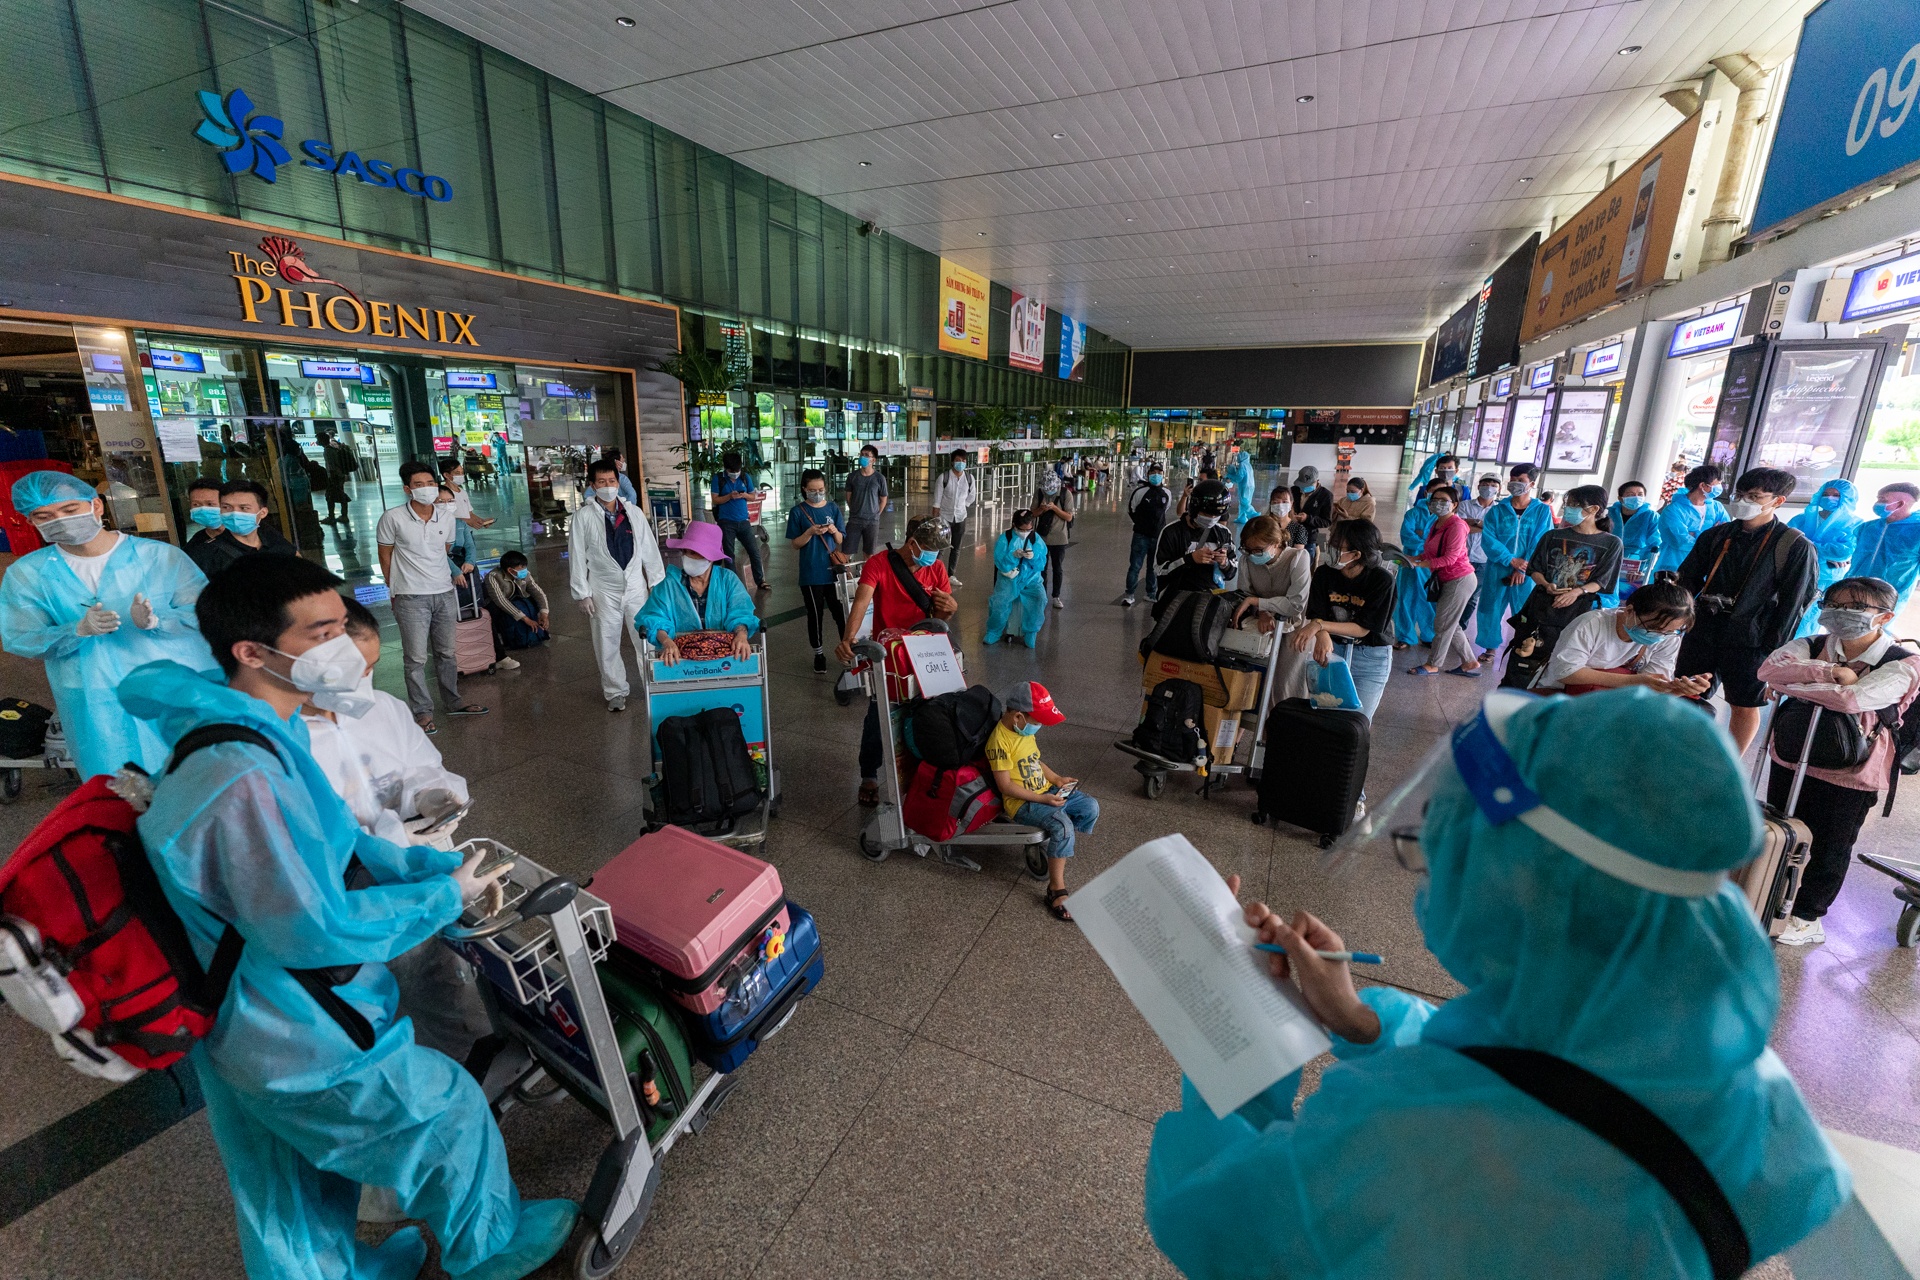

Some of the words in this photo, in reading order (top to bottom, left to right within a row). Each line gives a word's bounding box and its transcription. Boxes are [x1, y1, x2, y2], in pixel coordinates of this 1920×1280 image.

[1845, 43, 1920, 156] 09
[301, 139, 453, 202] SASCO
[1593, 208, 1606, 232] xe
[1607, 196, 1622, 223] Be
[1597, 234, 1607, 261] B
[228, 250, 277, 277] The
[232, 275, 481, 347] PHOENIX
[1559, 289, 1573, 317] ga
[1693, 322, 1726, 338] VIETBANK
[1786, 383, 1847, 396] Cappuccino
[1806, 374, 1835, 382] Legend
[1329, 593, 1350, 603] TOP
[682, 666, 722, 676] VietinBank
[940, 660, 950, 674] LỆ
